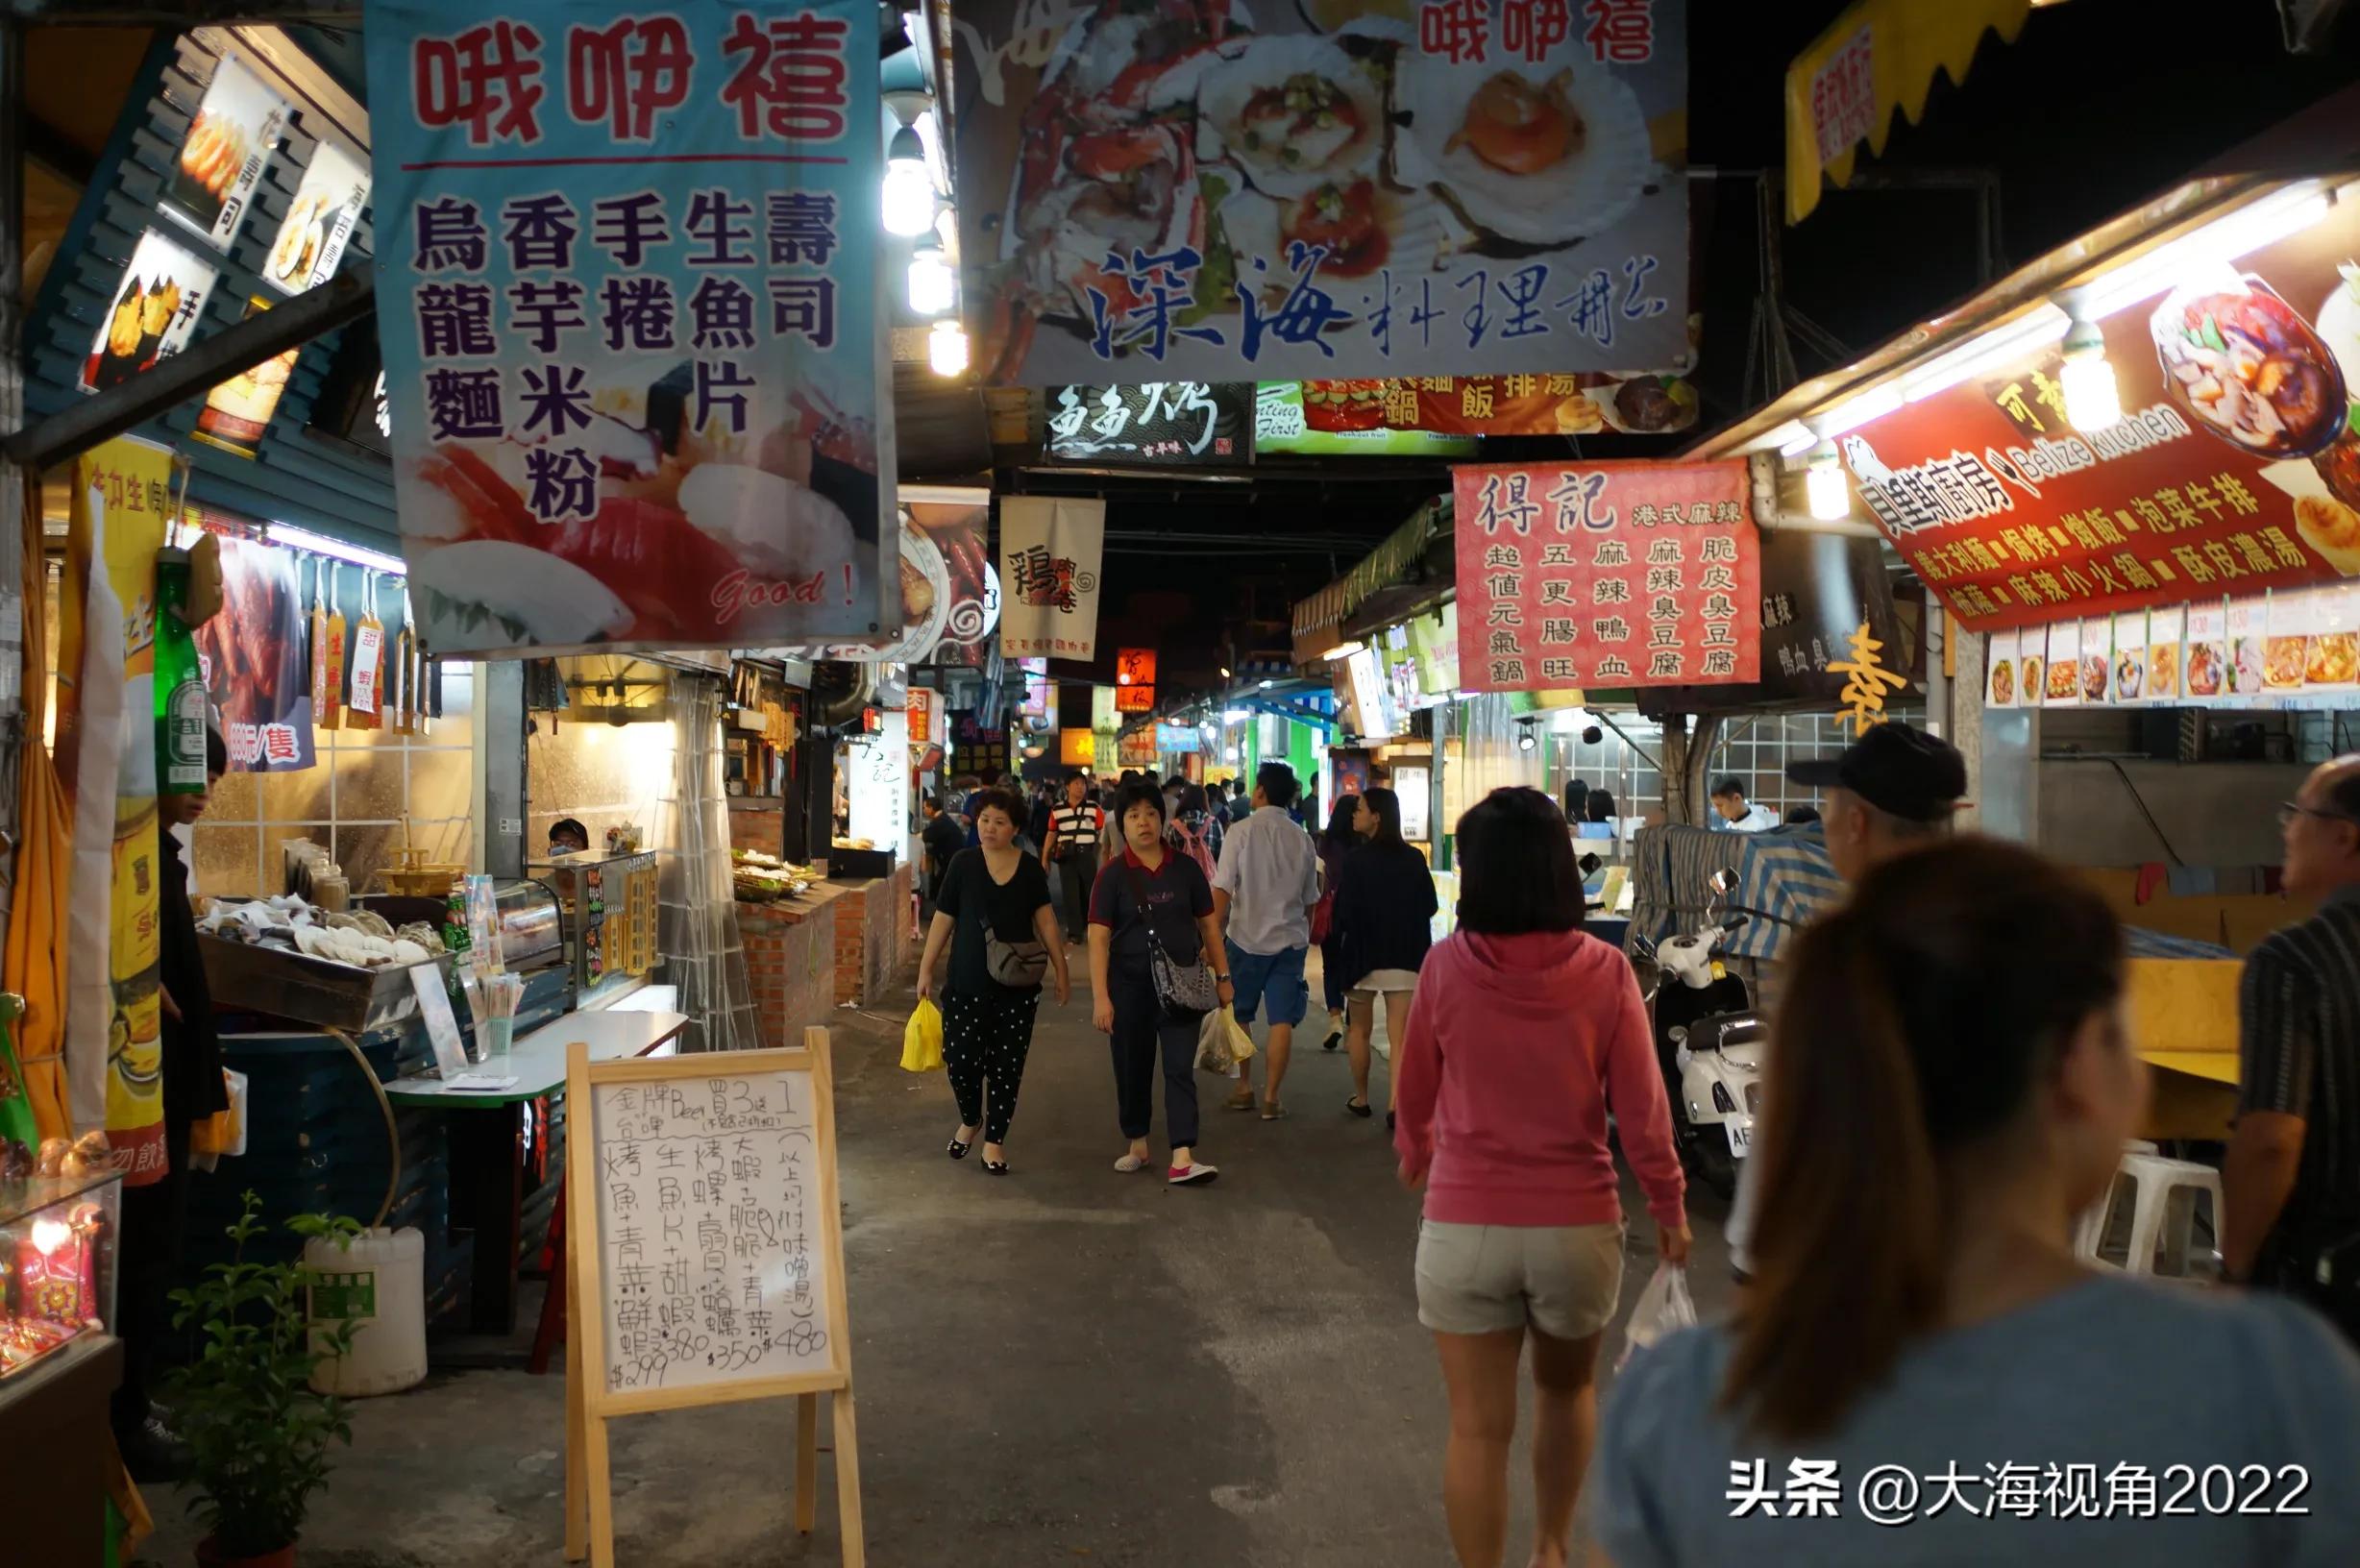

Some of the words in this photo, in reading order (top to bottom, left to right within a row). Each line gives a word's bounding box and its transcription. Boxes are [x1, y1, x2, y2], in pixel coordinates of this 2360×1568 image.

[416, 14, 848, 143] 哦咿禧
[413, 198, 503, 440] 烏龍麵
[595, 194, 675, 351] 手捲
[687, 193, 756, 432] 生魚片
[768, 194, 836, 348] 壽司
[504, 195, 600, 519] 香芋米粉
[1477, 474, 1615, 533] 得記
[1633, 502, 1742, 527] 港式麻辣
[2011, 438, 2091, 480] Belize
[2136, 472, 2261, 534] 泡菜牛排
[1487, 545, 1524, 684] 超值元氣鍋
[1540, 545, 1576, 678] 五更腸旺
[1593, 542, 1630, 676] 麻辣鴨血
[1648, 539, 1684, 676] 麻辣臭豆腐
[1702, 537, 1737, 674] 脆皮臭豆腐
[2171, 525, 2308, 583] 酥皮濃湯
